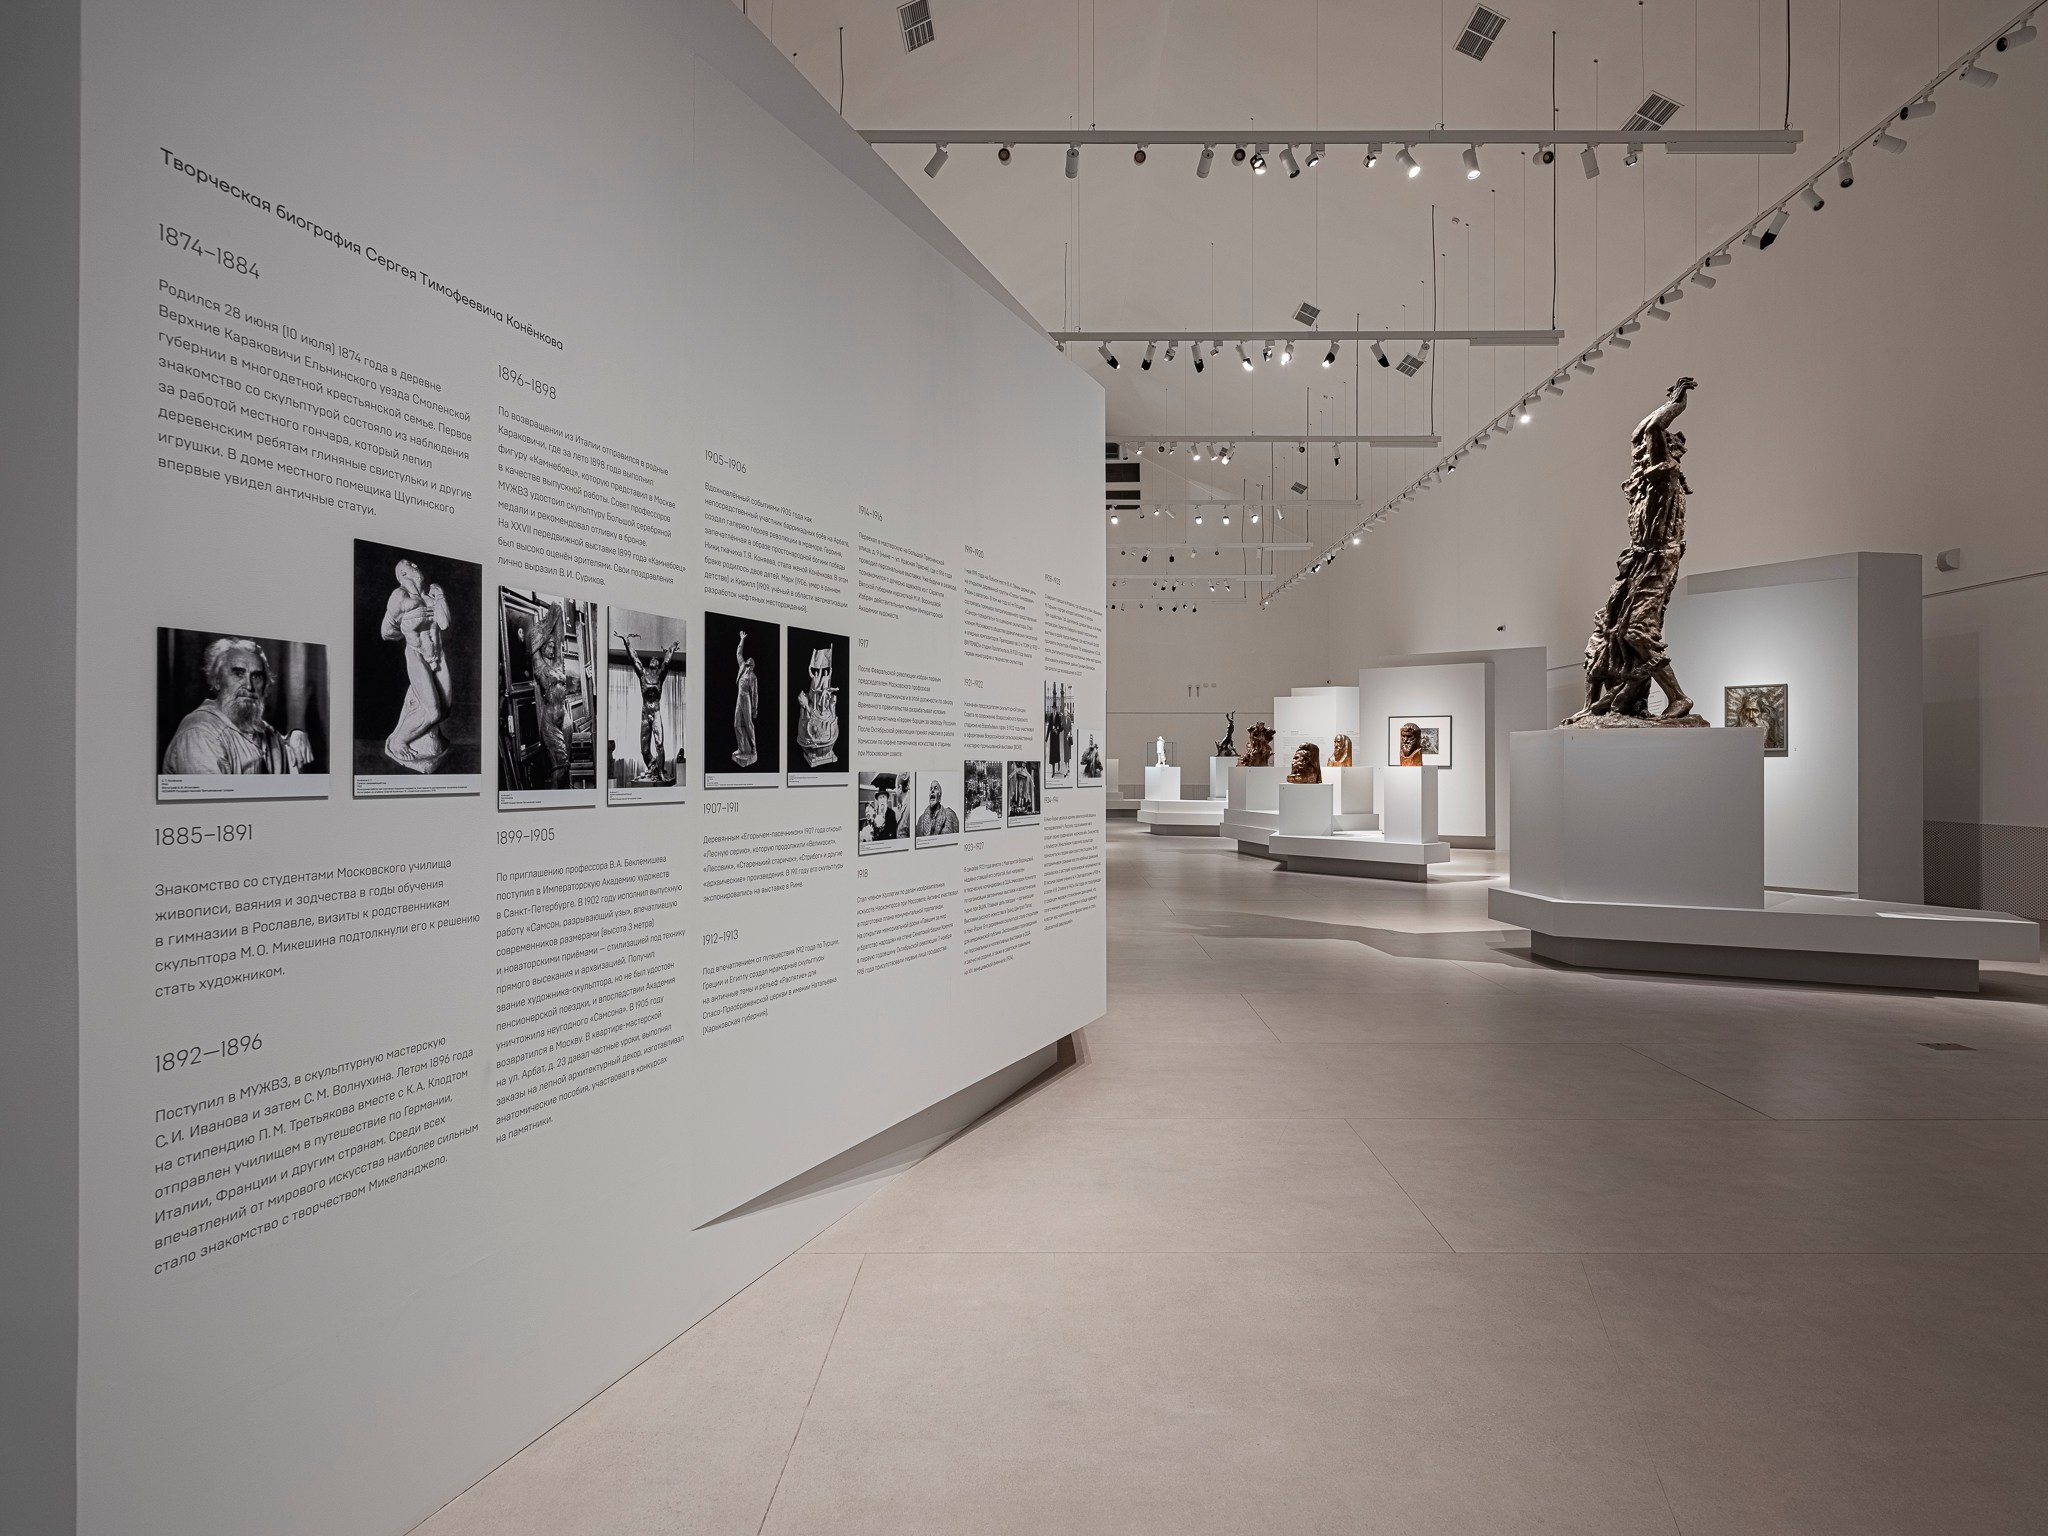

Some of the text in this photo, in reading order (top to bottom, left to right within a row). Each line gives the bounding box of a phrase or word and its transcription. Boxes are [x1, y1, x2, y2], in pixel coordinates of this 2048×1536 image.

[160, 147, 563, 350] Творческая биография Сергея Тимофеевича Конёнкова
[159, 278, 220, 312] Родился
[224, 303, 241, 320] 28
[245, 314, 278, 333] июня
[338, 345, 361, 363] 1874
[364, 357, 388, 373] года
[391, 367, 397, 377] в
[399, 371, 441, 393] деревне
[159, 304, 470, 422] Верхние Караковичи Ельнинского уезда Смоленской
[158, 357, 469, 460] знакомство со скульптурой состояло из наблюдения
[158, 382, 432, 469] за работой местного гончара, который лепил
[159, 332, 472, 442] губернии в многодетной крестьянской семье. Первое
[158, 407, 472, 500] деревенским ребятам глиняные свистульки и другие
[158, 433, 455, 514] игрушки. В доме местного помещика Щупинского
[498, 405, 510, 418] По
[511, 412, 563, 438] возвращении
[565, 432, 574, 442] из
[575, 434, 601, 451] Италии
[602, 446, 640, 465] отправился
[645, 462, 669, 476] родные
[548, 444, 562, 455] где
[562, 449, 571, 458] за
[572, 452, 589, 464] лето
[590, 456, 605, 470] 1898
[606, 464, 622, 475] года
[622, 469, 654, 486] выполнил
[158, 457, 377, 516] впервые увидел античные статуи.
[498, 500, 529, 515] медали
[537, 511, 590, 532] рекомендовал
[590, 526, 618, 540] отливку
[155, 859, 452, 897] Знакомство со студентами Московского училища
[155, 880, 444, 922] живописи, ваяния и зодчества в годы обучения
[496, 888, 535, 901] поступил
[542, 880, 601, 894] Императорскую
[601, 875, 636, 886] Академию
[637, 871, 670, 882] художеств
[155, 899, 450, 947] в гимназии в Рославле, визиты к родственникам
[496, 938, 558, 957] современников
[559, 930, 600, 946] размерами
[155, 967, 285, 998] стать художником.
[155, 1037, 446, 1123] Поступил в МУЖВЗ, в скульптурную мастерскую
[155, 1095, 453, 1199] отправлен училищем в путешествие по Германии,
[155, 1116, 446, 1224] Италии, Франции и другим странам. Среди всех
[155, 1124, 479, 1250] впечатлений от мирового искусства наиболее сильным
[154, 1155, 448, 1275] стало знакомство с творчеством Микеланджело.
